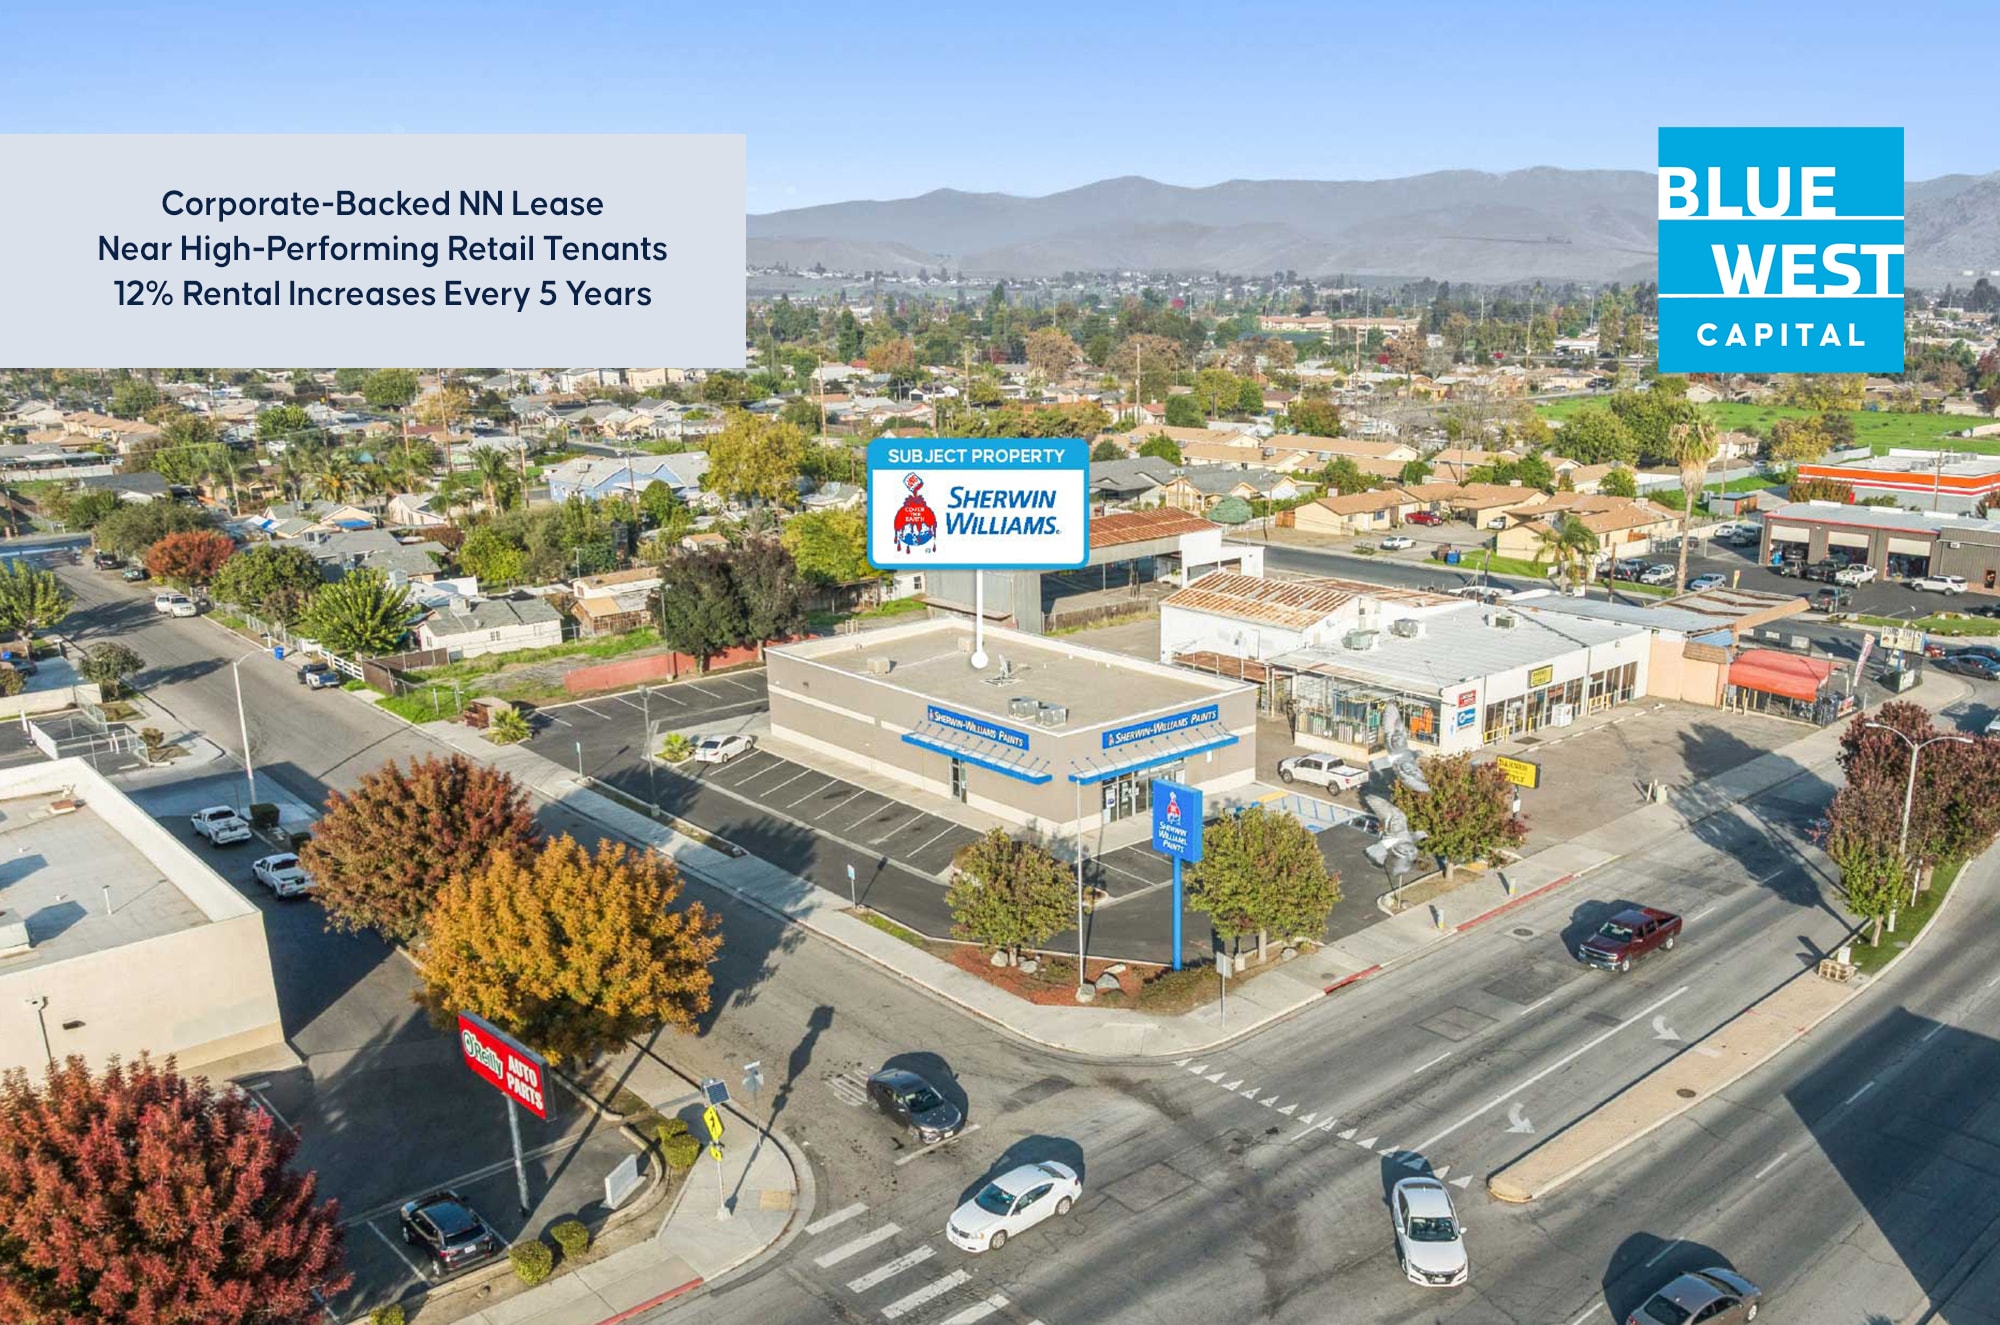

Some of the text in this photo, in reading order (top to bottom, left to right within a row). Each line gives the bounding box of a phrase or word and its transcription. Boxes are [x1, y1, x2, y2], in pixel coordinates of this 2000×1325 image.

[1190, 710, 1217, 724] PAINTS
[999, 730, 1024, 747] PAINTS
[1159, 821, 1187, 837] SHERWIN
[1162, 840, 1184, 853] PAINTS
[462, 1028, 504, 1080] O'Reilly
[508, 1054, 538, 1088] AUTO
[506, 1072, 544, 1110] PARTS
